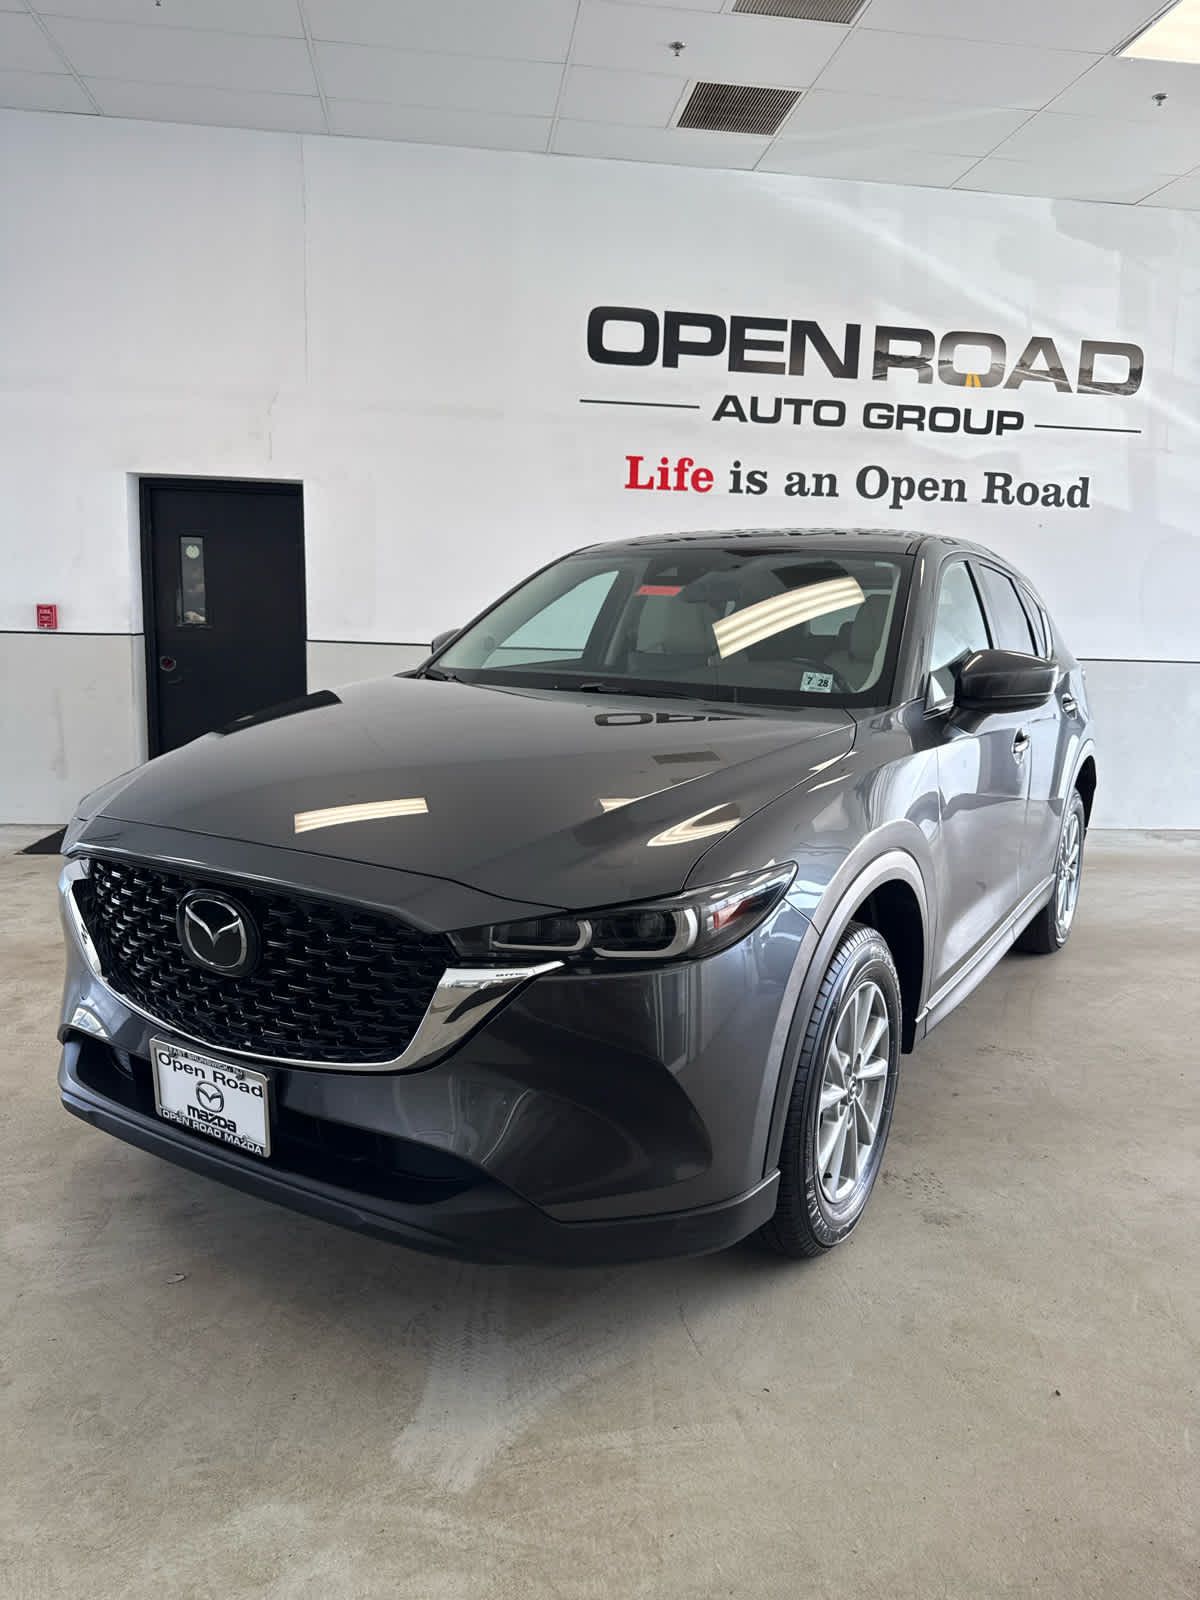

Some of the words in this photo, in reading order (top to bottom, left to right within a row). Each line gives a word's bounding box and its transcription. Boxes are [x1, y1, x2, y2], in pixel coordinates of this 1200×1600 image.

[587, 305, 861, 381] OPEN
[872, 324, 1145, 396] ROAD
[712, 394, 846, 428] AUTO
[863, 402, 1024, 436] GROUP
[624, 456, 714, 493] Life
[728, 461, 768, 495] is
[784, 469, 839, 498] an
[855, 464, 967, 509] Open
[981, 471, 1091, 508] Road
[807, 676, 813, 685] 7
[817, 679, 829, 687] 28
[158, 1052, 206, 1080] Open
[212, 1070, 264, 1098] Road
[162, 1109, 190, 1126] OPEN
[192, 1122, 222, 1138] ROAD
[224, 1132, 263, 1155] MAZDA
